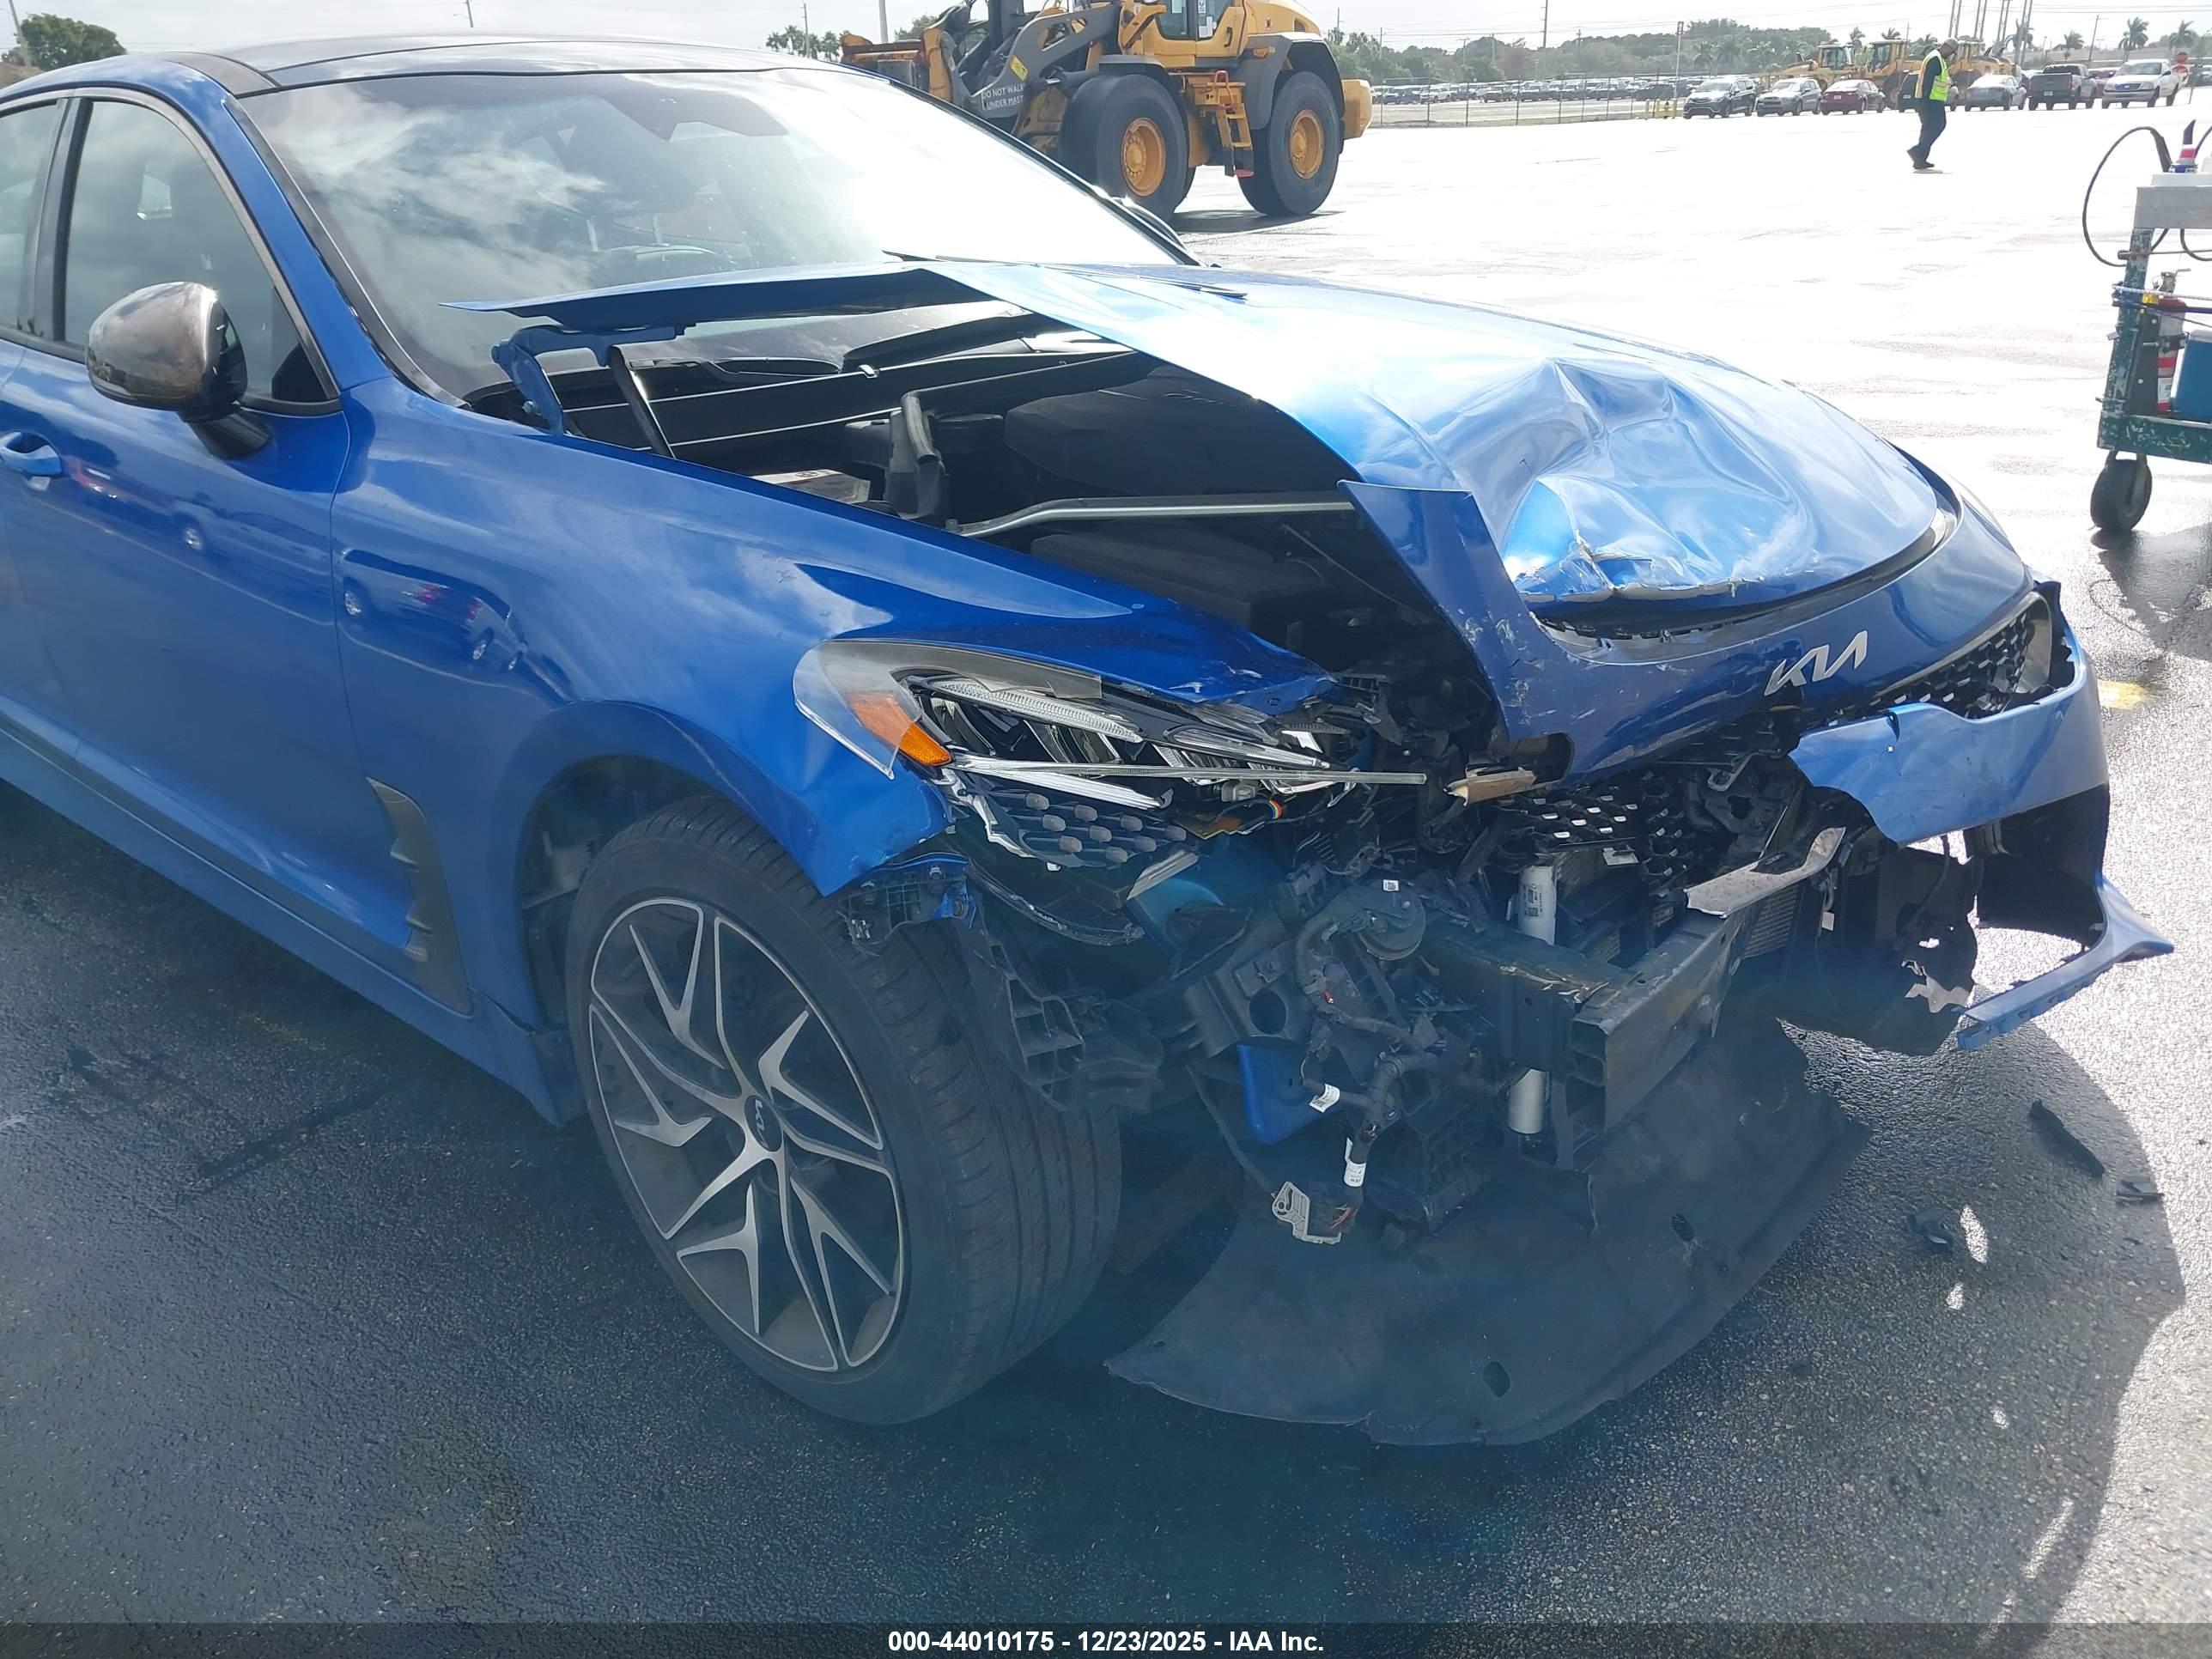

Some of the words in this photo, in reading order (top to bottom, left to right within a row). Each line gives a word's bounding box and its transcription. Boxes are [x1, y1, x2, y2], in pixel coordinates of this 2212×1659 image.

[993, 87, 1006, 97] NOT
[987, 99, 1007, 110] UNDER
[1008, 95, 1024, 105] MAST
[1764, 629, 1869, 697] KIA
